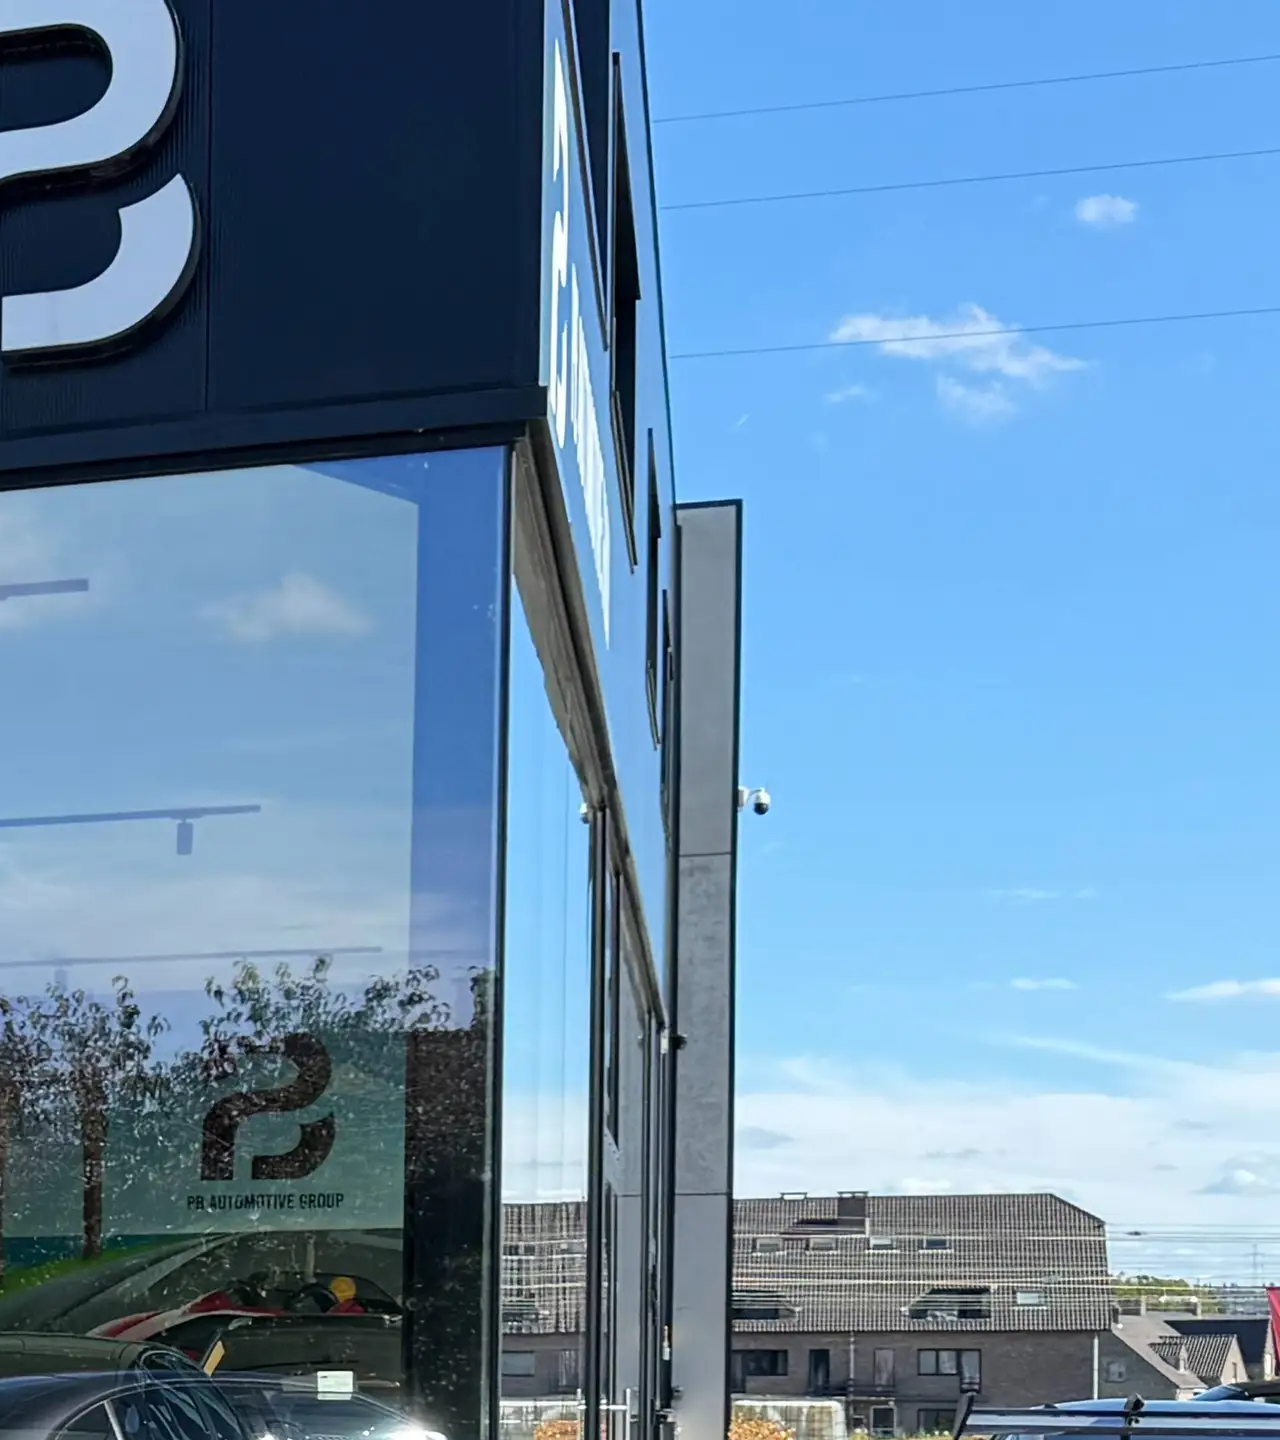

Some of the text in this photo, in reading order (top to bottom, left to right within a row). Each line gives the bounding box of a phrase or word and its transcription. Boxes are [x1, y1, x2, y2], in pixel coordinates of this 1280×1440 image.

[187, 1192, 345, 1210] PB AUTOMOTIVE GROUP
